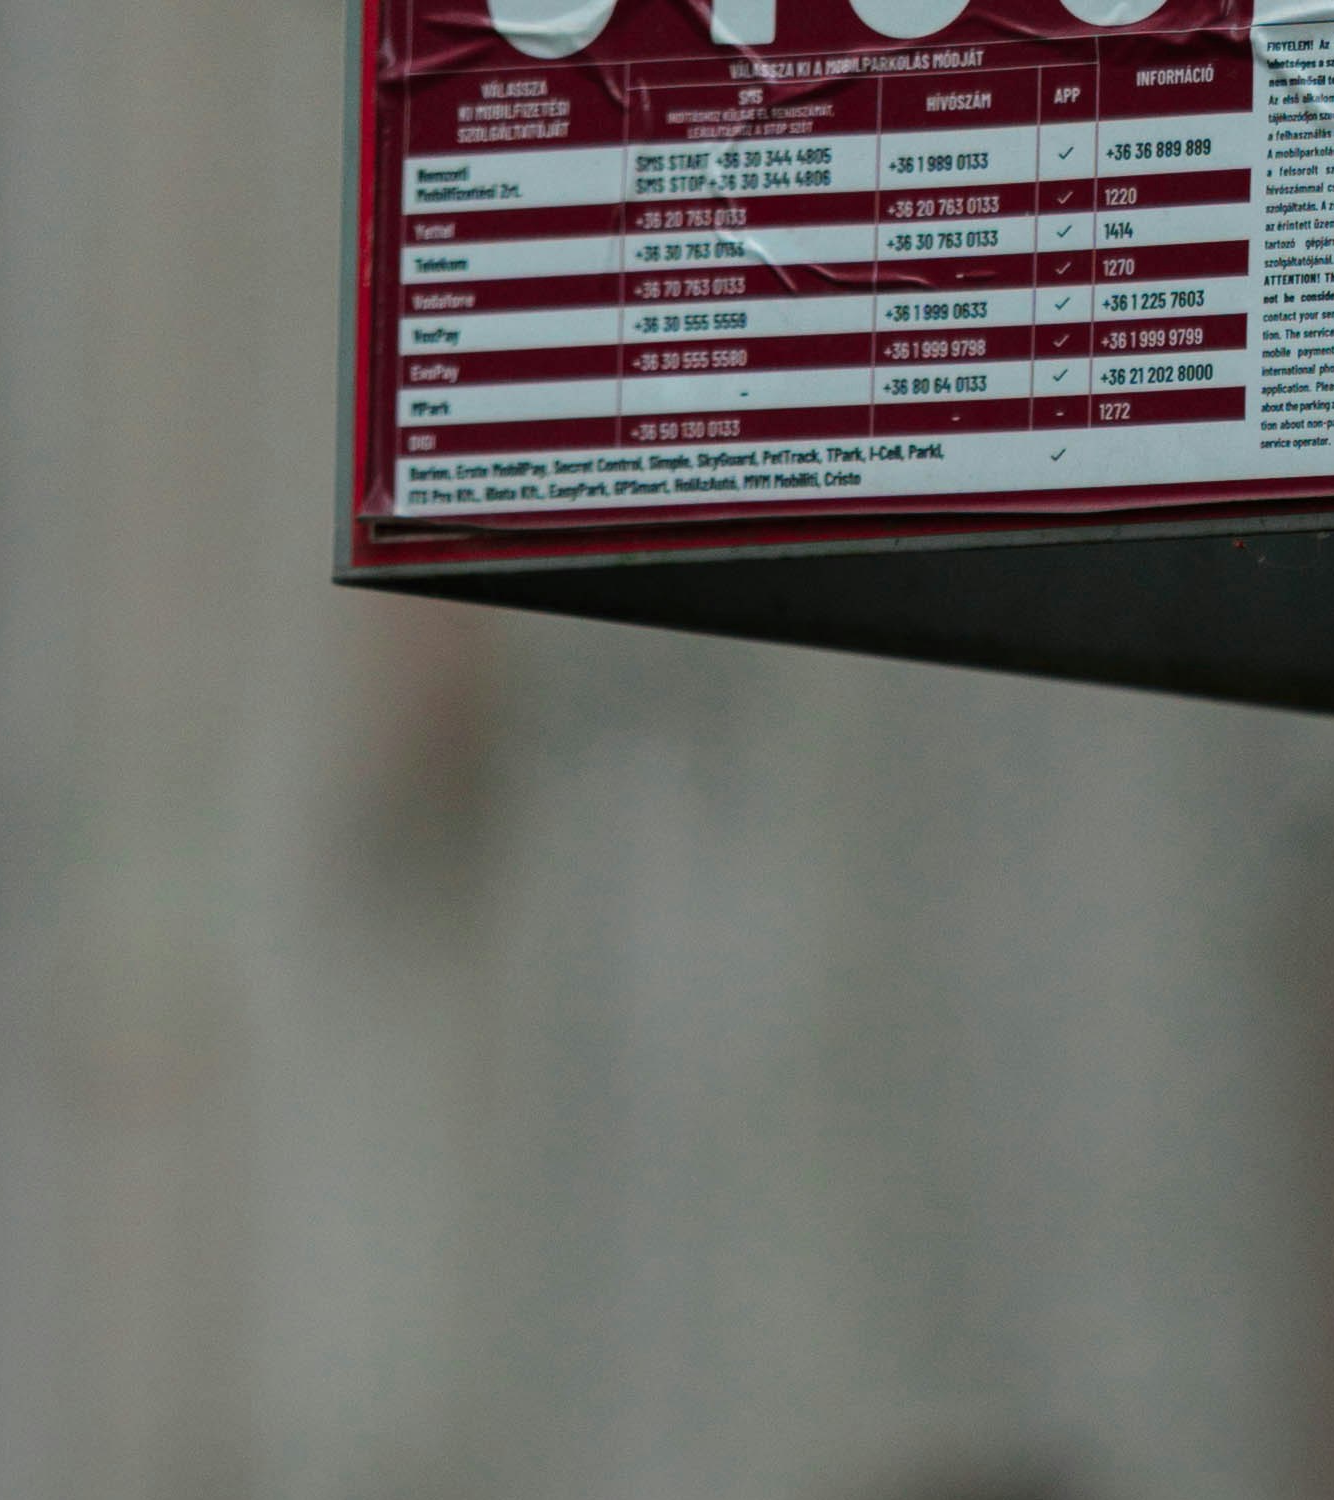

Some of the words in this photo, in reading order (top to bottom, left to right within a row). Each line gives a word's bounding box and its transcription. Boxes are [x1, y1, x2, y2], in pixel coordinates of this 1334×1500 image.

[1136, 63, 1214, 86] INFORMÁCIÓ
[926, 92, 991, 111] HÍVÓSZÁM
[1054, 86, 1080, 103] APP
[1106, 143, 1131, 160] +36
[1135, 142, 1152, 159] 36
[1156, 140, 1181, 158] 889
[1185, 138, 1211, 156] 889
[889, 156, 914, 173] +36
[927, 154, 952, 172] 989
[956, 152, 988, 170] 0133
[1105, 187, 1137, 205] 1220
[888, 200, 913, 218] +36
[916, 199, 934, 217] 20
[938, 197, 963, 215] 763
[966, 195, 999, 214] 0133
[1104, 222, 1133, 239] 1414
[887, 234, 912, 251] +36
[916, 233, 933, 250] 30
[937, 231, 962, 248] 763
[966, 230, 998, 247] 0133
[1103, 258, 1134, 276] 1270
[1264, 273, 1320, 285] ATTENTION!
[1102, 294, 1127, 311] +36
[1141, 292, 1166, 310] 225
[1170, 289, 1204, 308] 7603
[1263, 294, 1278, 303] not
[1284, 293, 1294, 303] be
[885, 305, 910, 321] +36
[923, 303, 949, 320] 999
[953, 301, 987, 319] 0633
[1263, 311, 1296, 322] contact
[1299, 311, 1318, 322] your
[1101, 332, 1126, 349] +36
[1139, 329, 1165, 347] 999
[1169, 327, 1203, 346] 9799
[1262, 330, 1280, 340] tion.
[1285, 329, 1300, 338] The
[1303, 327, 1334, 338] service
[884, 342, 909, 359] +36
[921, 340, 948, 358] 999
[951, 339, 985, 357] 9798
[1262, 347, 1291, 358] mobile
[1297, 346, 1334, 358] payment
[1101, 368, 1125, 385] +36
[1129, 367, 1143, 384] 21
[1147, 365, 1173, 383] 202
[1177, 363, 1213, 381] 8000
[883, 378, 908, 395] +36
[912, 377, 930, 394] 80
[933, 377, 951, 393] 64
[955, 375, 986, 392] 0133
[1099, 402, 1130, 420] 1272
